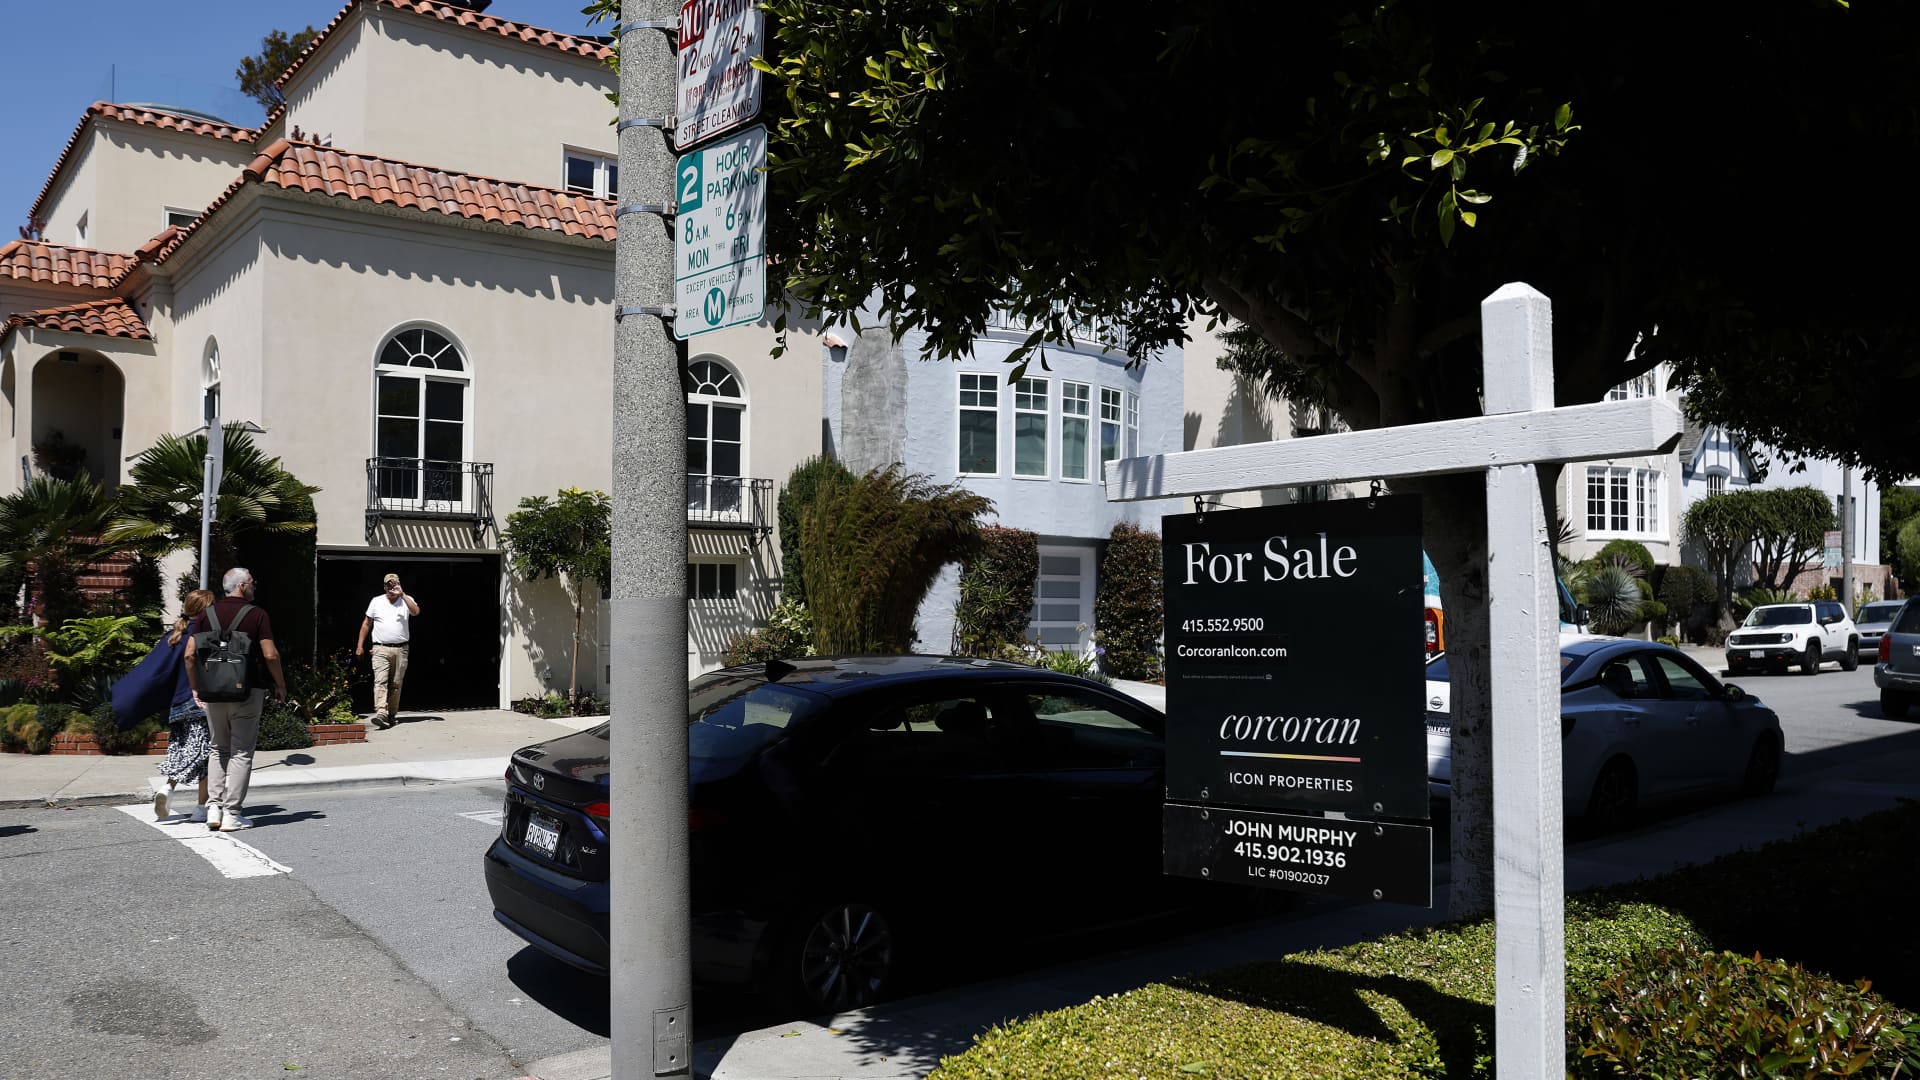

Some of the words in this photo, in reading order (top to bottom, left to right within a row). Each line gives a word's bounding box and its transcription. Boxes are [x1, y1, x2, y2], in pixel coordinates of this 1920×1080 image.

[682, 0, 703, 43] NO
[707, 0, 759, 29] PARKI
[683, 47, 698, 79] 12
[700, 51, 714, 71] NOON
[719, 37, 725, 48] TO
[731, 26, 740, 55] 2
[683, 116, 710, 141] STREET
[711, 97, 752, 127] CLEANING
[681, 165, 699, 204] 2
[716, 145, 749, 174] HOUR
[707, 166, 759, 201] PARKING
[685, 217, 694, 245] 8
[696, 224, 711, 241] A.M.
[715, 207, 722, 217] TO
[725, 203, 735, 231] 6
[738, 209, 754, 228] P.M.
[688, 247, 709, 271] MON
[733, 233, 749, 257] FRI
[686, 280, 706, 295] EXCEPT
[708, 270, 736, 288] VEHICLES
[685, 308, 700, 319] AREA
[707, 290, 722, 322] M
[728, 293, 754, 309] PERMITS
[1182, 542, 1253, 585] For
[1264, 532, 1358, 582] Sale
[1182, 617, 1265, 633] 415.552.9500
[1177, 644, 1287, 657] CorcoranIcon.com
[1219, 714, 1361, 745] corcoran
[1229, 772, 1264, 786] ICON
[1269, 775, 1353, 792] PROPERTIES
[1225, 820, 1273, 840] JOHN
[1278, 825, 1357, 848] MURPHY
[1234, 842, 1346, 868] 415.902.1936
[1248, 866, 1266, 878] LIC
[1269, 868, 1330, 886] #01902037
